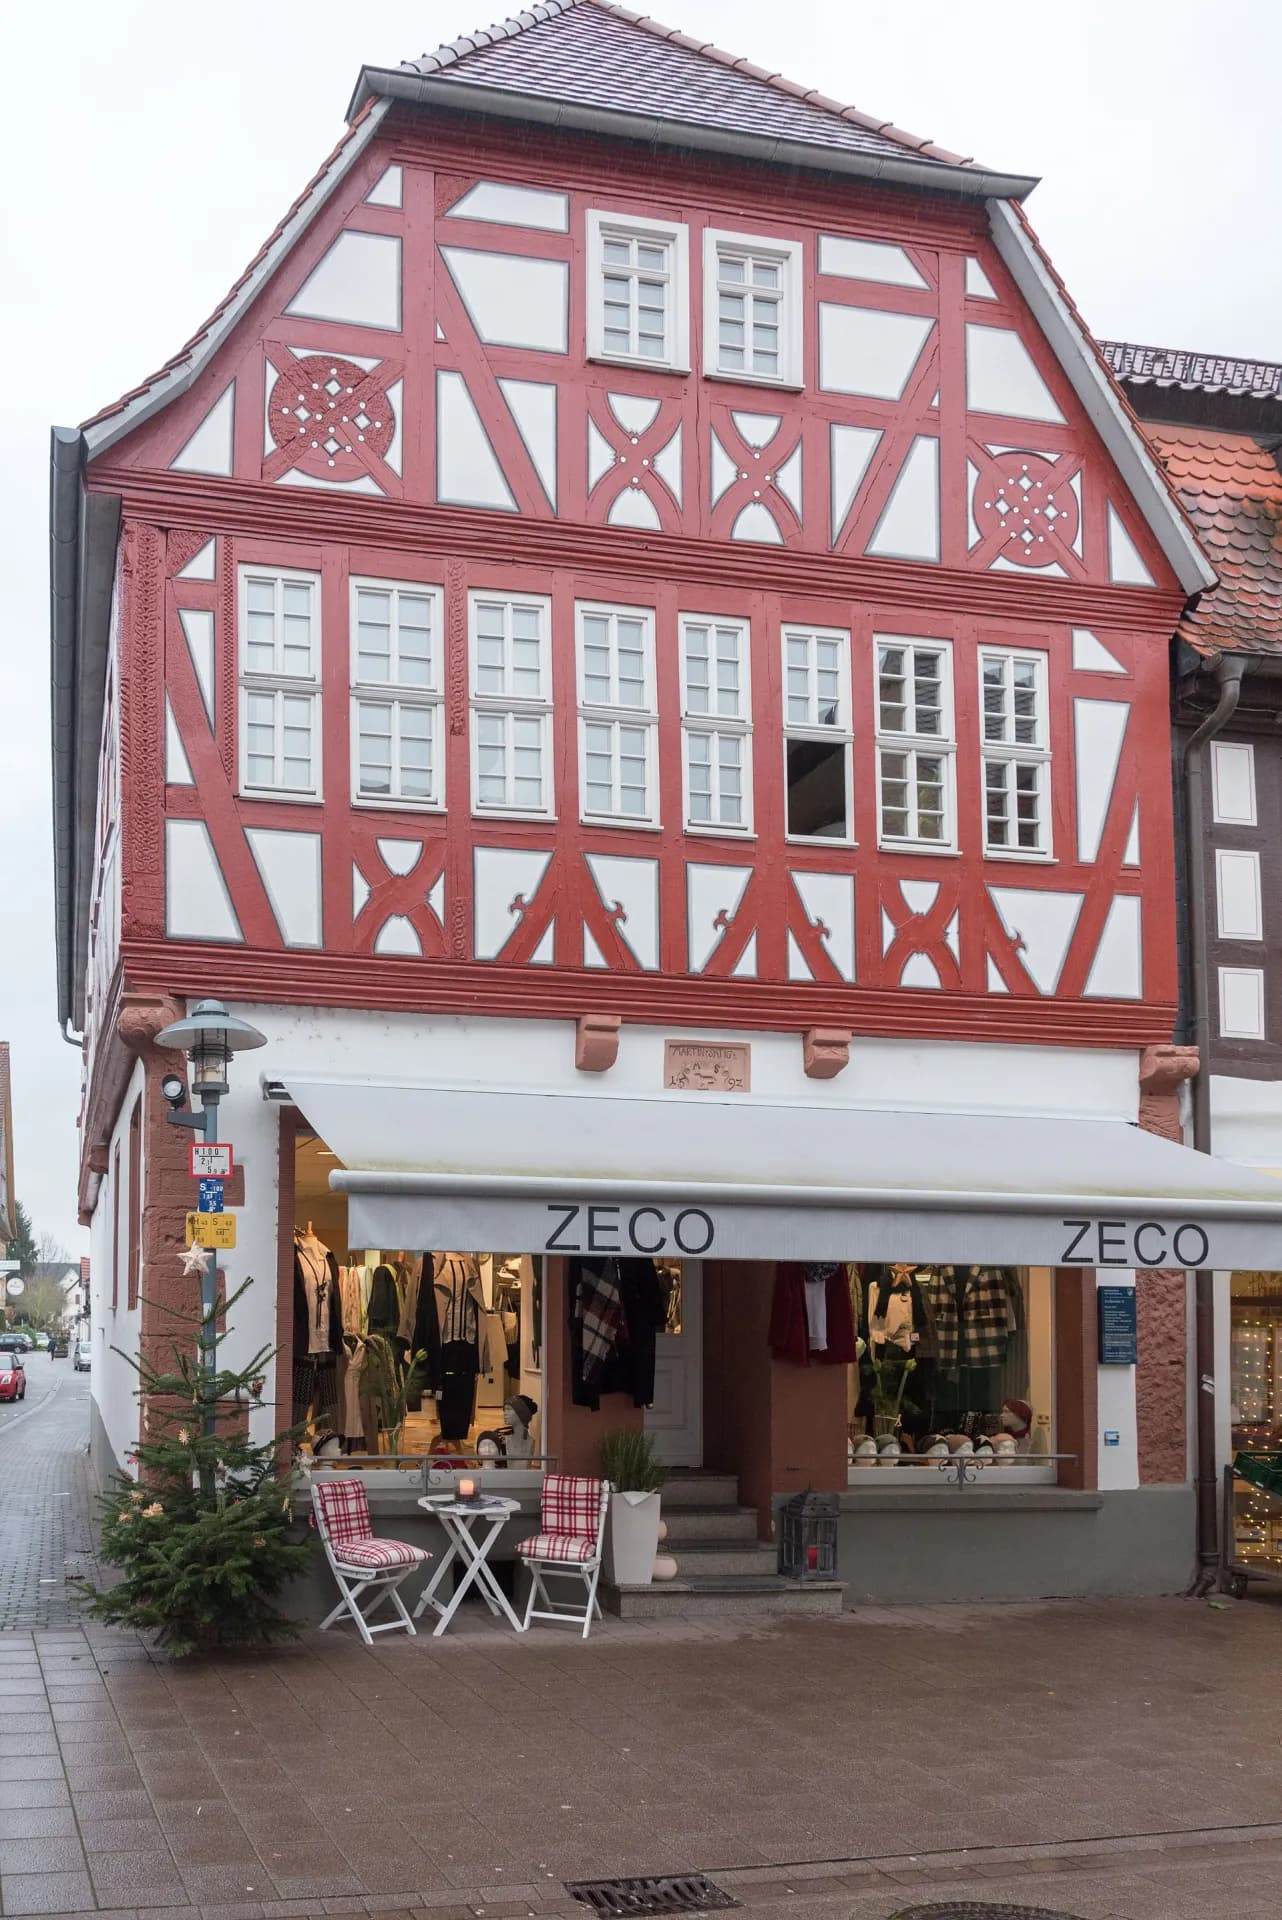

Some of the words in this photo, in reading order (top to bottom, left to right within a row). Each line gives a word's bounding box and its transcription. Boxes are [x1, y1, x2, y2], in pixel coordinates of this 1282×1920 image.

[199, 1182, 207, 1191] S
[545, 1204, 715, 1255] ZECO
[1061, 1220, 1209, 1267] ZECO
